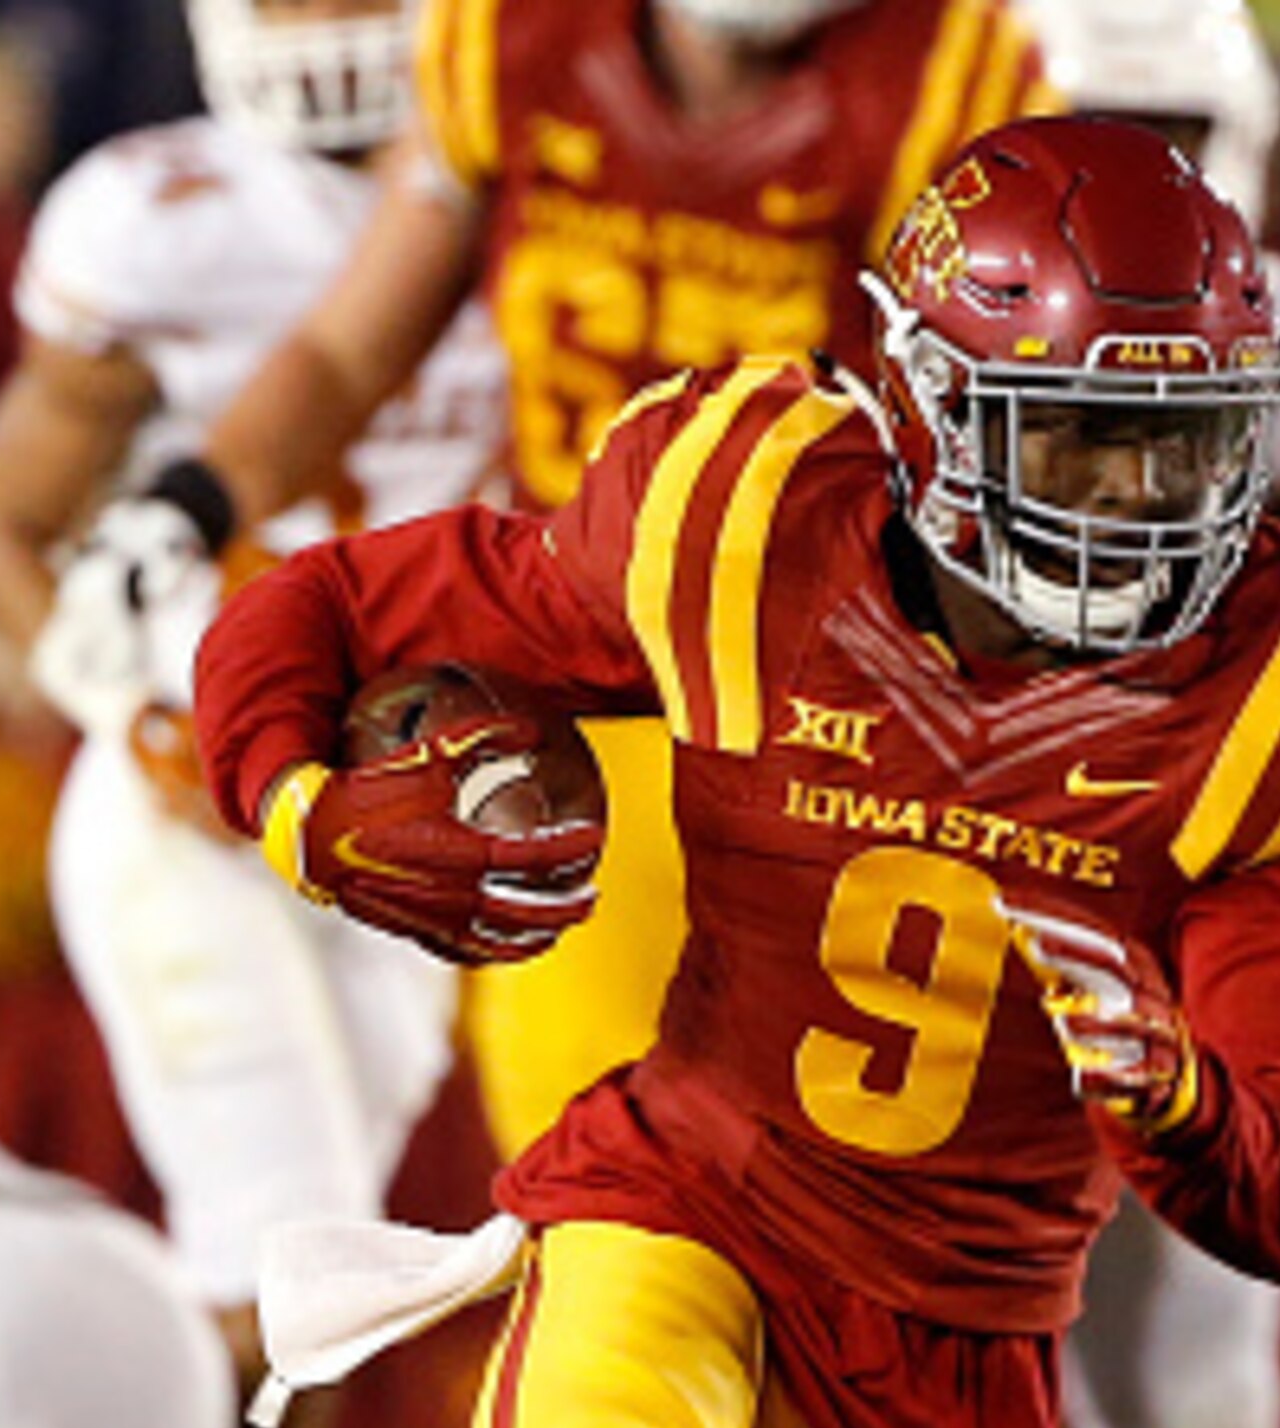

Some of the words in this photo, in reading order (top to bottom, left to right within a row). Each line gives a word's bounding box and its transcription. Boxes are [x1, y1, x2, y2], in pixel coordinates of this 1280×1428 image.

[773, 697, 880, 765] XII
[782, 776, 925, 842] IOWA
[936, 805, 1119, 887] STATE
[795, 845, 1012, 1155] 9
